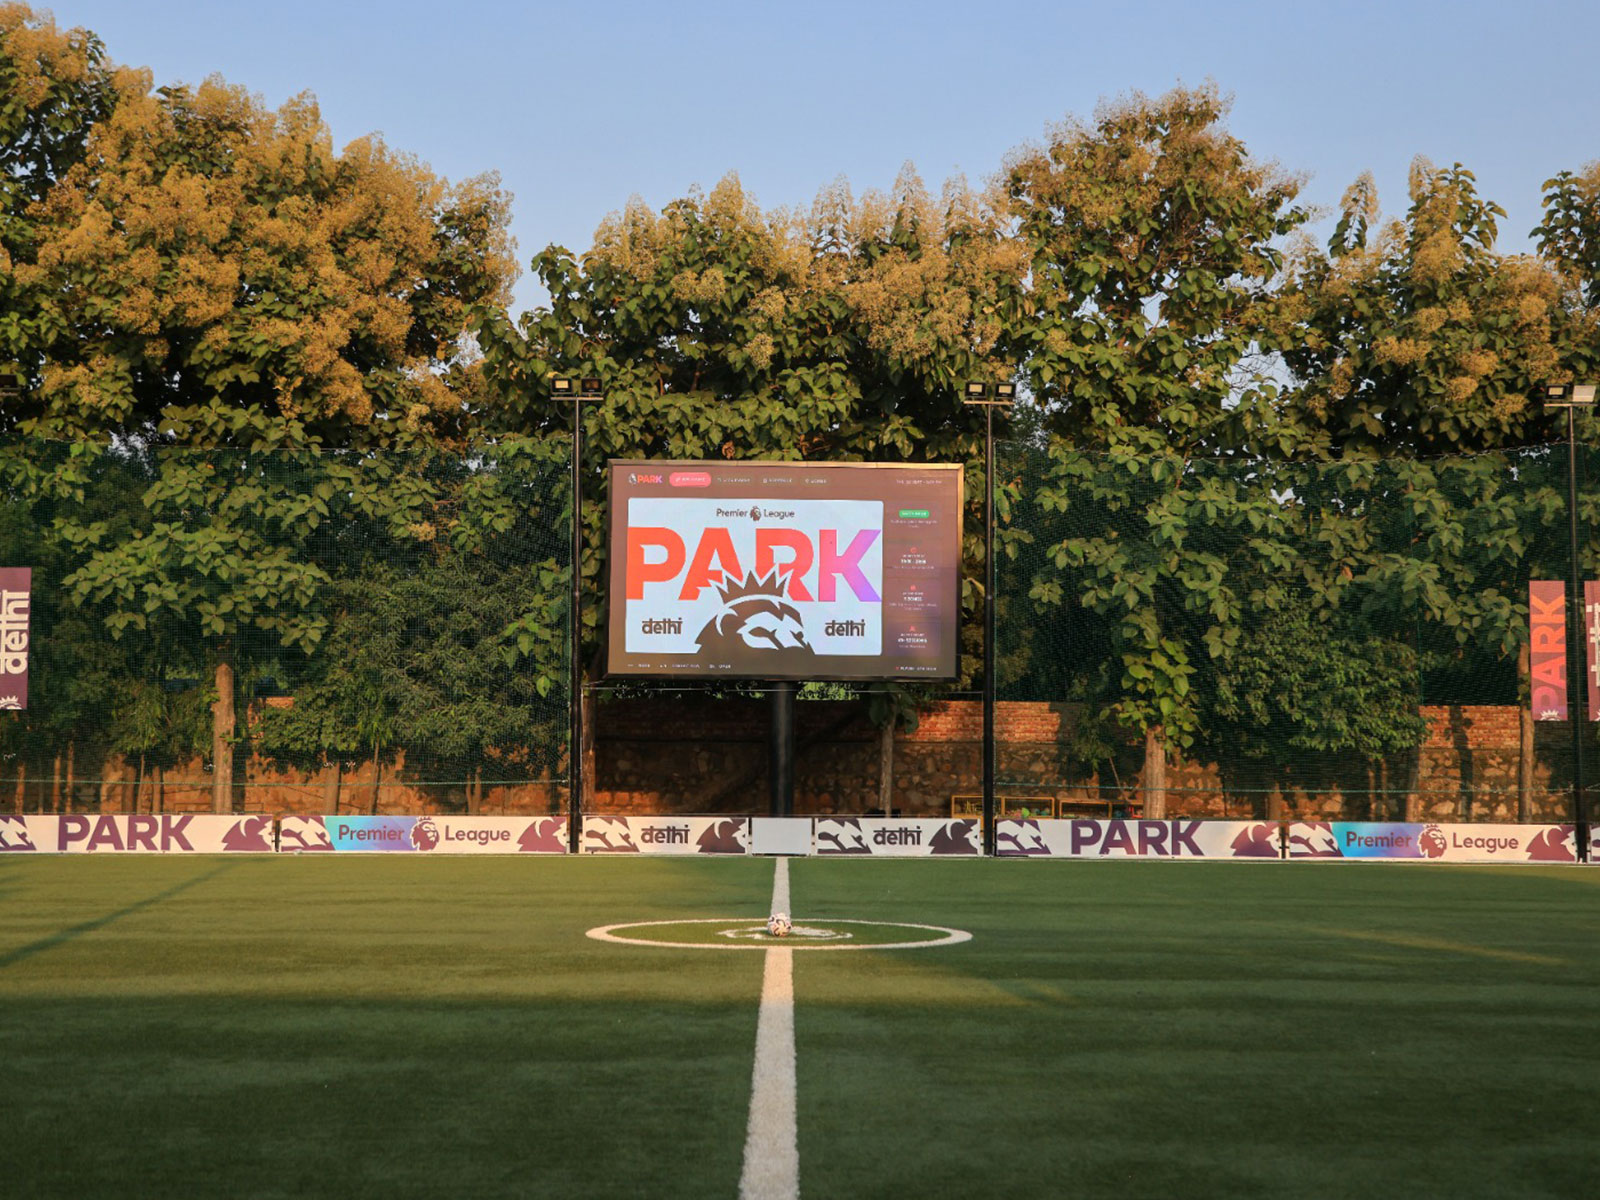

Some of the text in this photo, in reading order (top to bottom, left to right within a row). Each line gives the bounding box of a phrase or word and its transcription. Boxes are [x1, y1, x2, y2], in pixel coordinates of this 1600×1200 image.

[637, 474, 663, 484] PARK
[716, 508, 795, 520] Premier League
[626, 527, 882, 602] PARK
[642, 617, 683, 635] delhi
[825, 619, 866, 637] delhi
[1531, 594, 1567, 713] PARK
[57, 815, 195, 851] PARK
[338, 824, 511, 846] Premier League
[641, 824, 691, 845] delhi
[873, 826, 922, 846] delhi
[1071, 819, 1205, 856] PARK
[1346, 831, 1519, 850] Premier League
